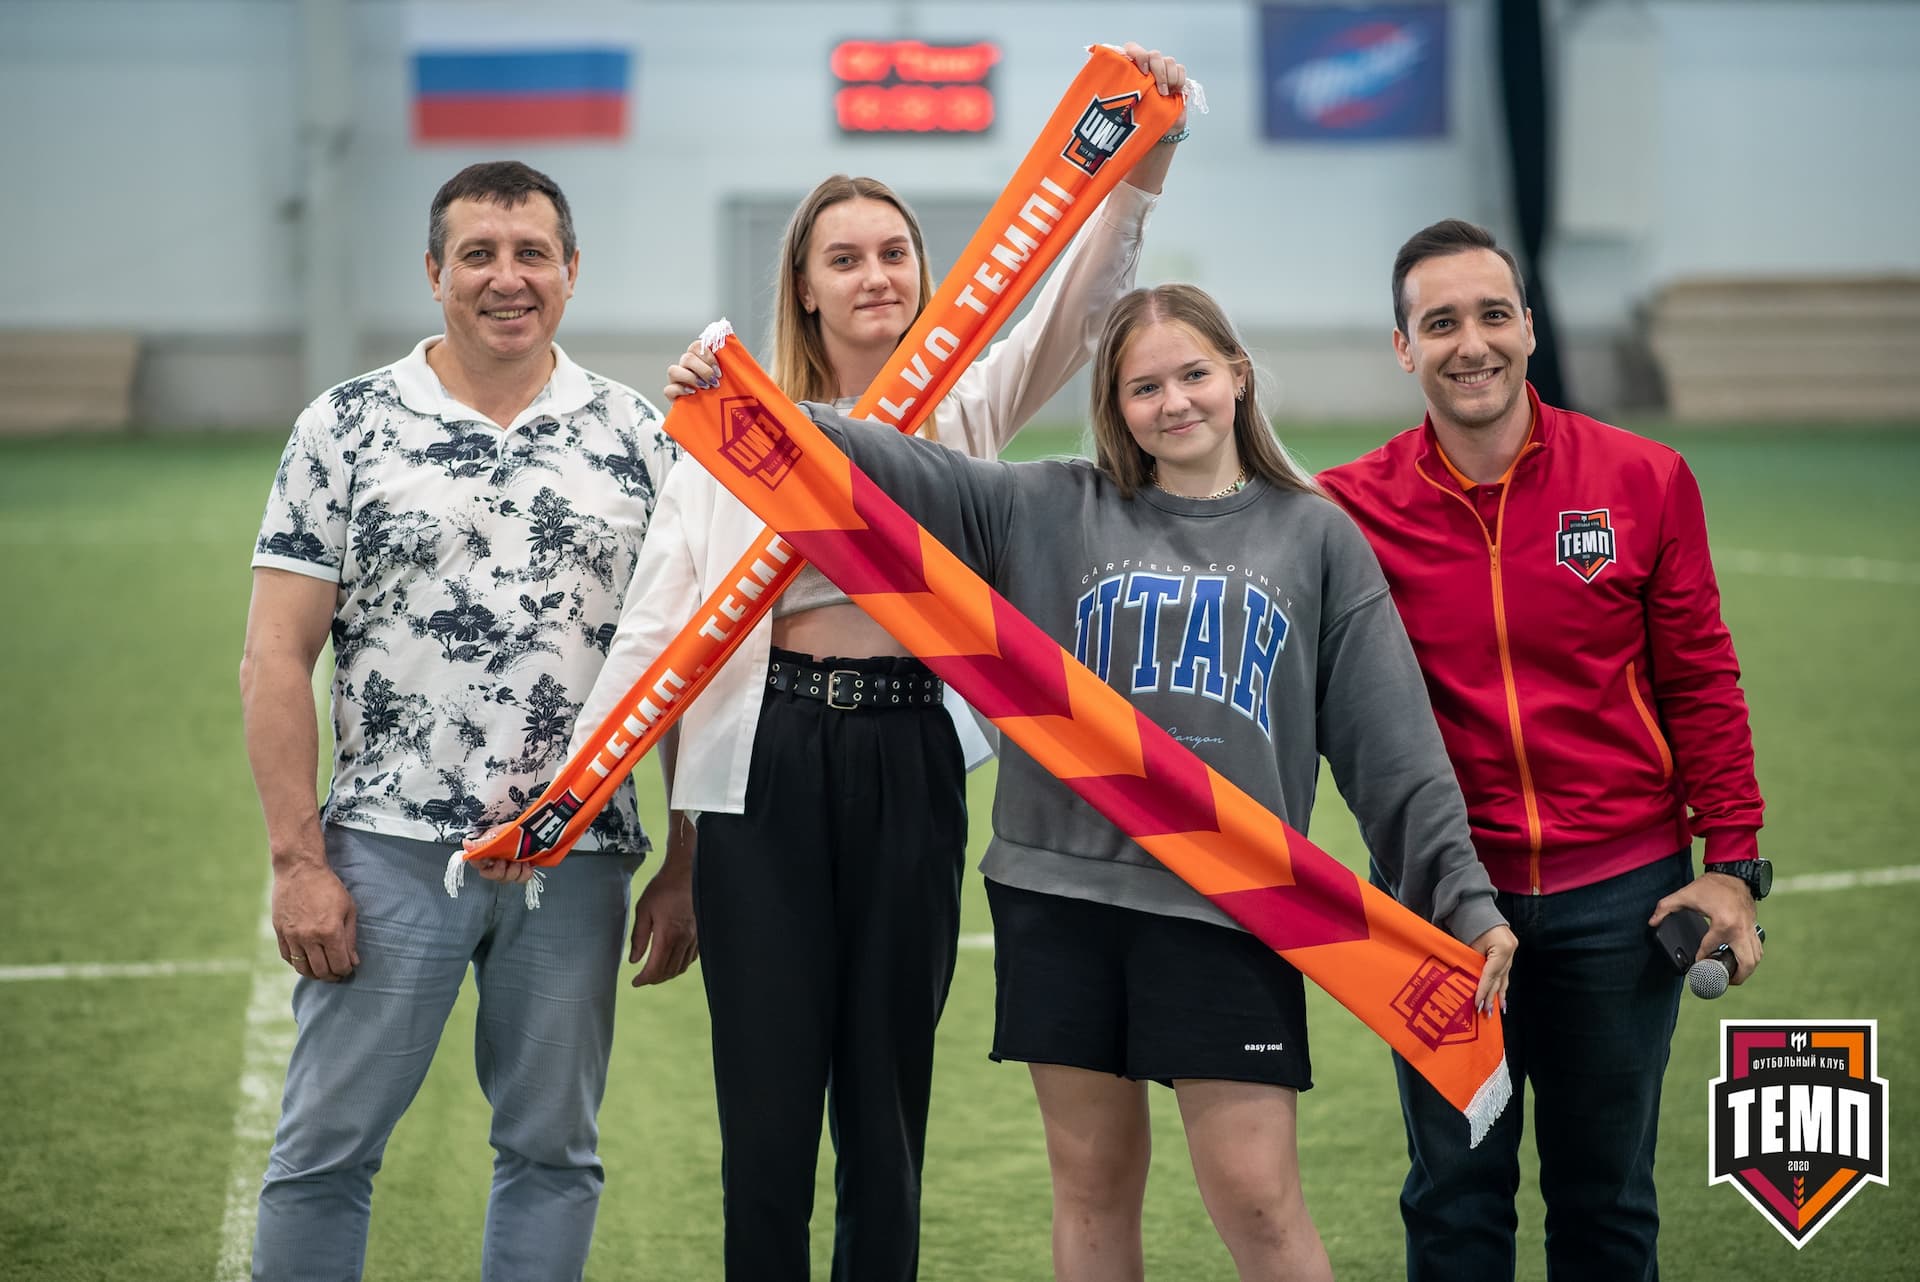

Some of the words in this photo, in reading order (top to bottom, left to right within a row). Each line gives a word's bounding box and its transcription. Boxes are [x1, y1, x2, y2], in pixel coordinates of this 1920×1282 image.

[1562, 530, 1610, 557] ТЕМП
[1082, 560, 1191, 584] GARFIELD
[1209, 563, 1292, 608] COUNTY
[1075, 571, 1290, 744] UTAH
[1412, 971, 1478, 1041] ТЕМП
[1244, 1043, 1265, 1053] easy
[1266, 1042, 1283, 1051] soul
